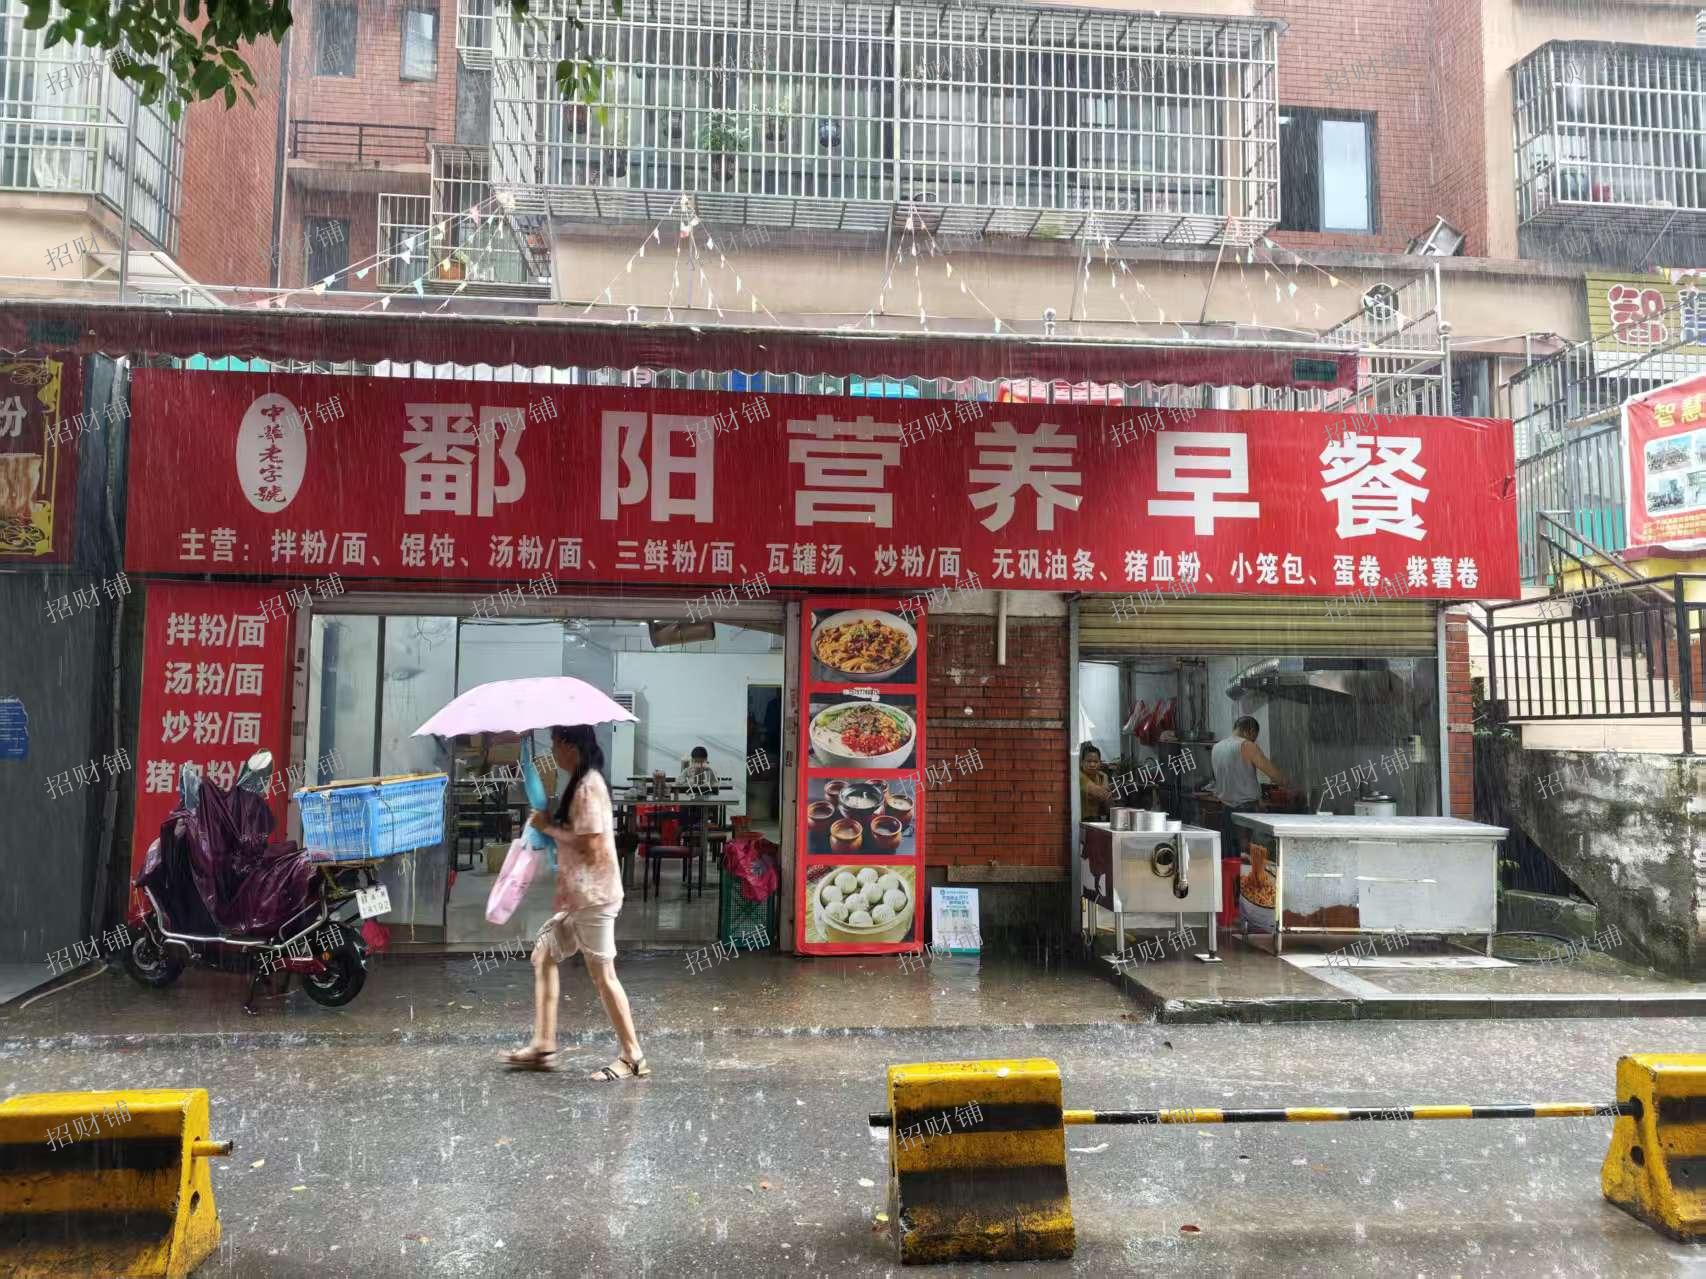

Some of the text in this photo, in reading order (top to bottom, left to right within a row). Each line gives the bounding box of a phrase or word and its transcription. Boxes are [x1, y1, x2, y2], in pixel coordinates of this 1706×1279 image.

[401, 403, 1430, 541] 鄱阳营养早餐
[167, 613, 266, 648] 拌粉/面
[164, 662, 265, 697] 汤粉/面
[161, 711, 261, 745] 炒粉/面
